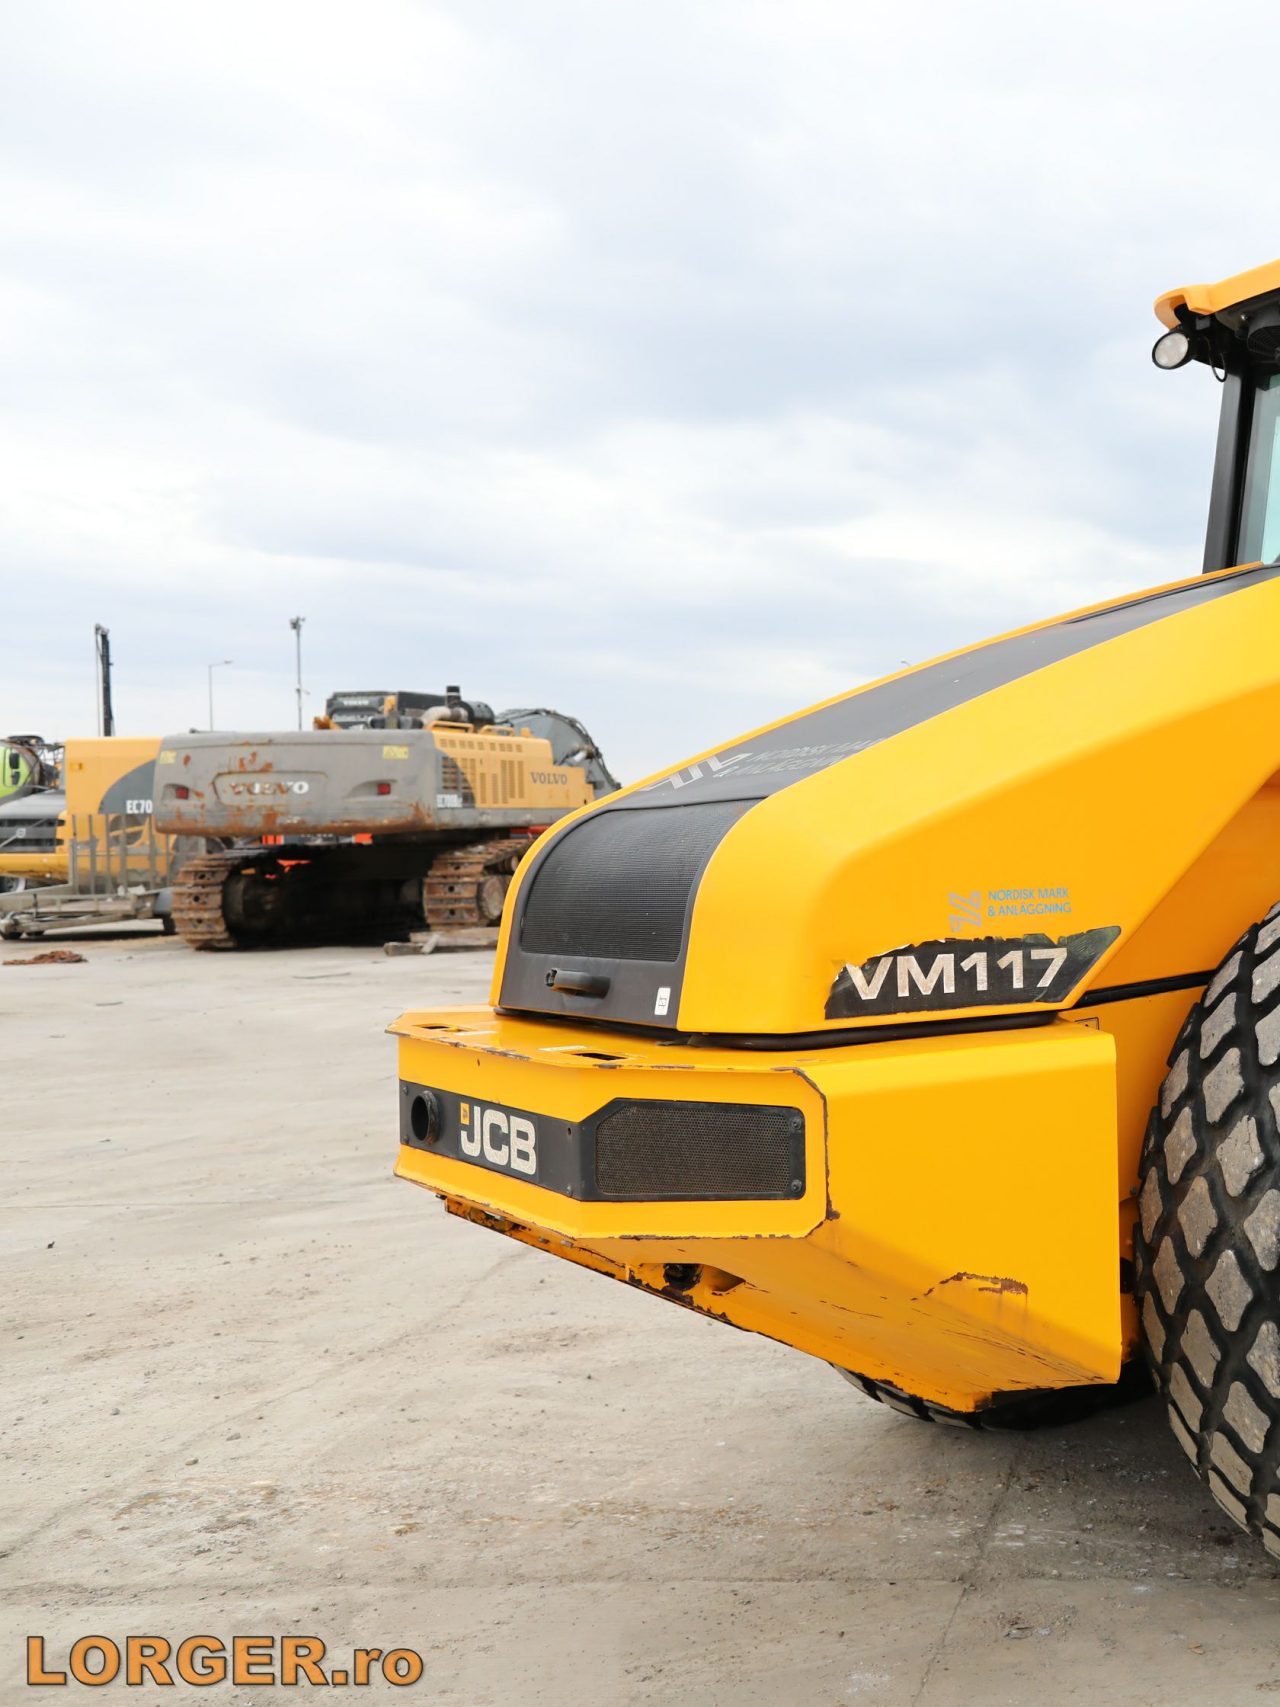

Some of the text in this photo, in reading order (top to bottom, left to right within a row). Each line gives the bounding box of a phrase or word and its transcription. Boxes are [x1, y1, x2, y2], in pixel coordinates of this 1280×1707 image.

[530, 772, 568, 784] VOLVO
[988, 887, 1069, 901] NORDISK MARK
[987, 902, 1072, 917] & ANLÄGGNING
[845, 948, 1068, 1000] VM117
[460, 1105, 537, 1175] JCB
